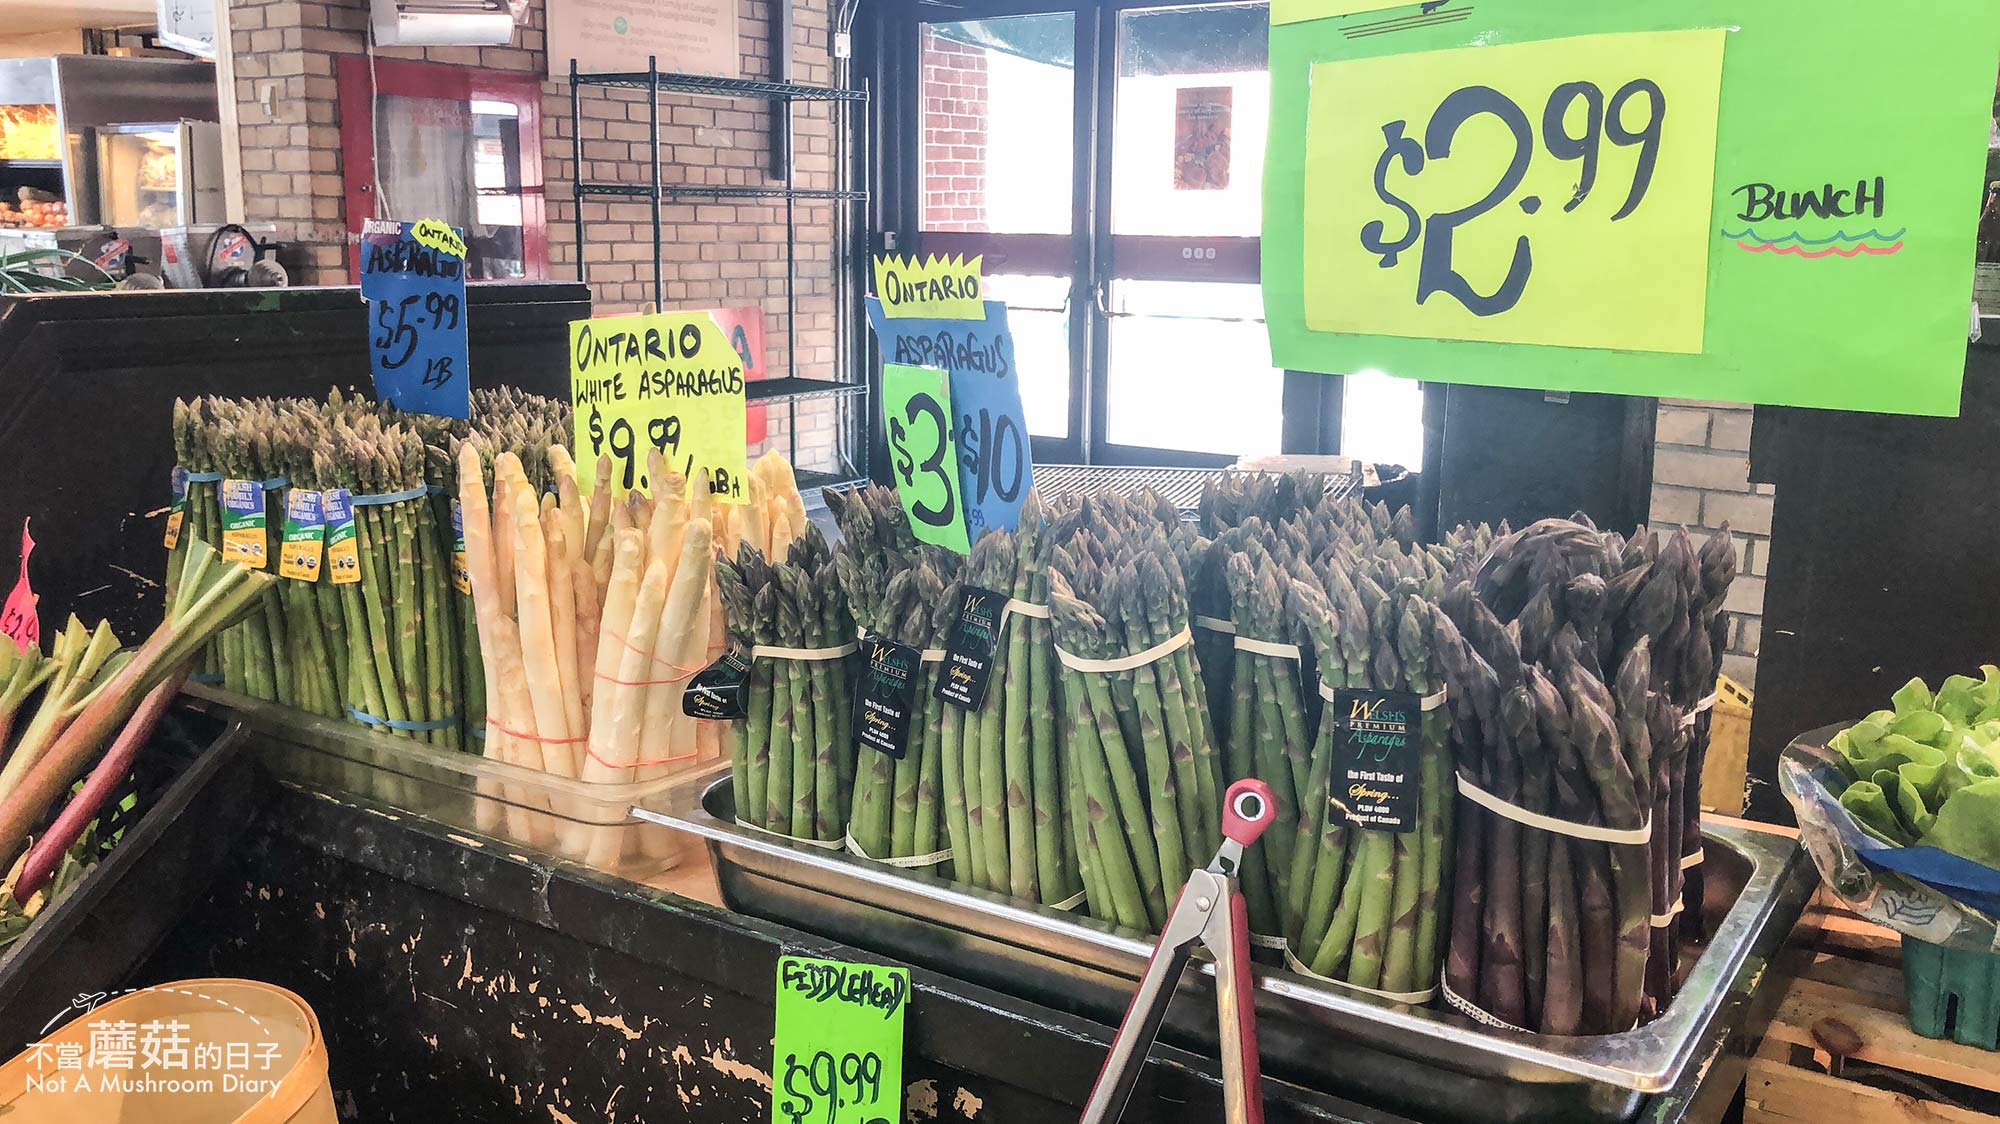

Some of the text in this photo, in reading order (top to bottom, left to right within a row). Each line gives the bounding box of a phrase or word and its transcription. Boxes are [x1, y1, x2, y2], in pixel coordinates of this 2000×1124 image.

[1360, 78, 1666, 316] $2.99
[1731, 176, 1884, 222] BUNCH
[886, 271, 978, 305] ONTARIO
[376, 291, 459, 370] $5.99
[577, 324, 702, 372] ONTARIO
[422, 356, 453, 390] LB
[895, 331, 1008, 378] ASPARAGUS
[576, 367, 743, 408] WHITE ASPARAGUS
[1349, 698, 1406, 722] WELSH'S
[1350, 720, 1406, 732] PREMIUM
[1347, 730, 1407, 762] Asparagus
[1360, 770, 1376, 781] First
[1376, 771, 1395, 783] Taste
[782, 960, 906, 1020] FIDDLEHEAD
